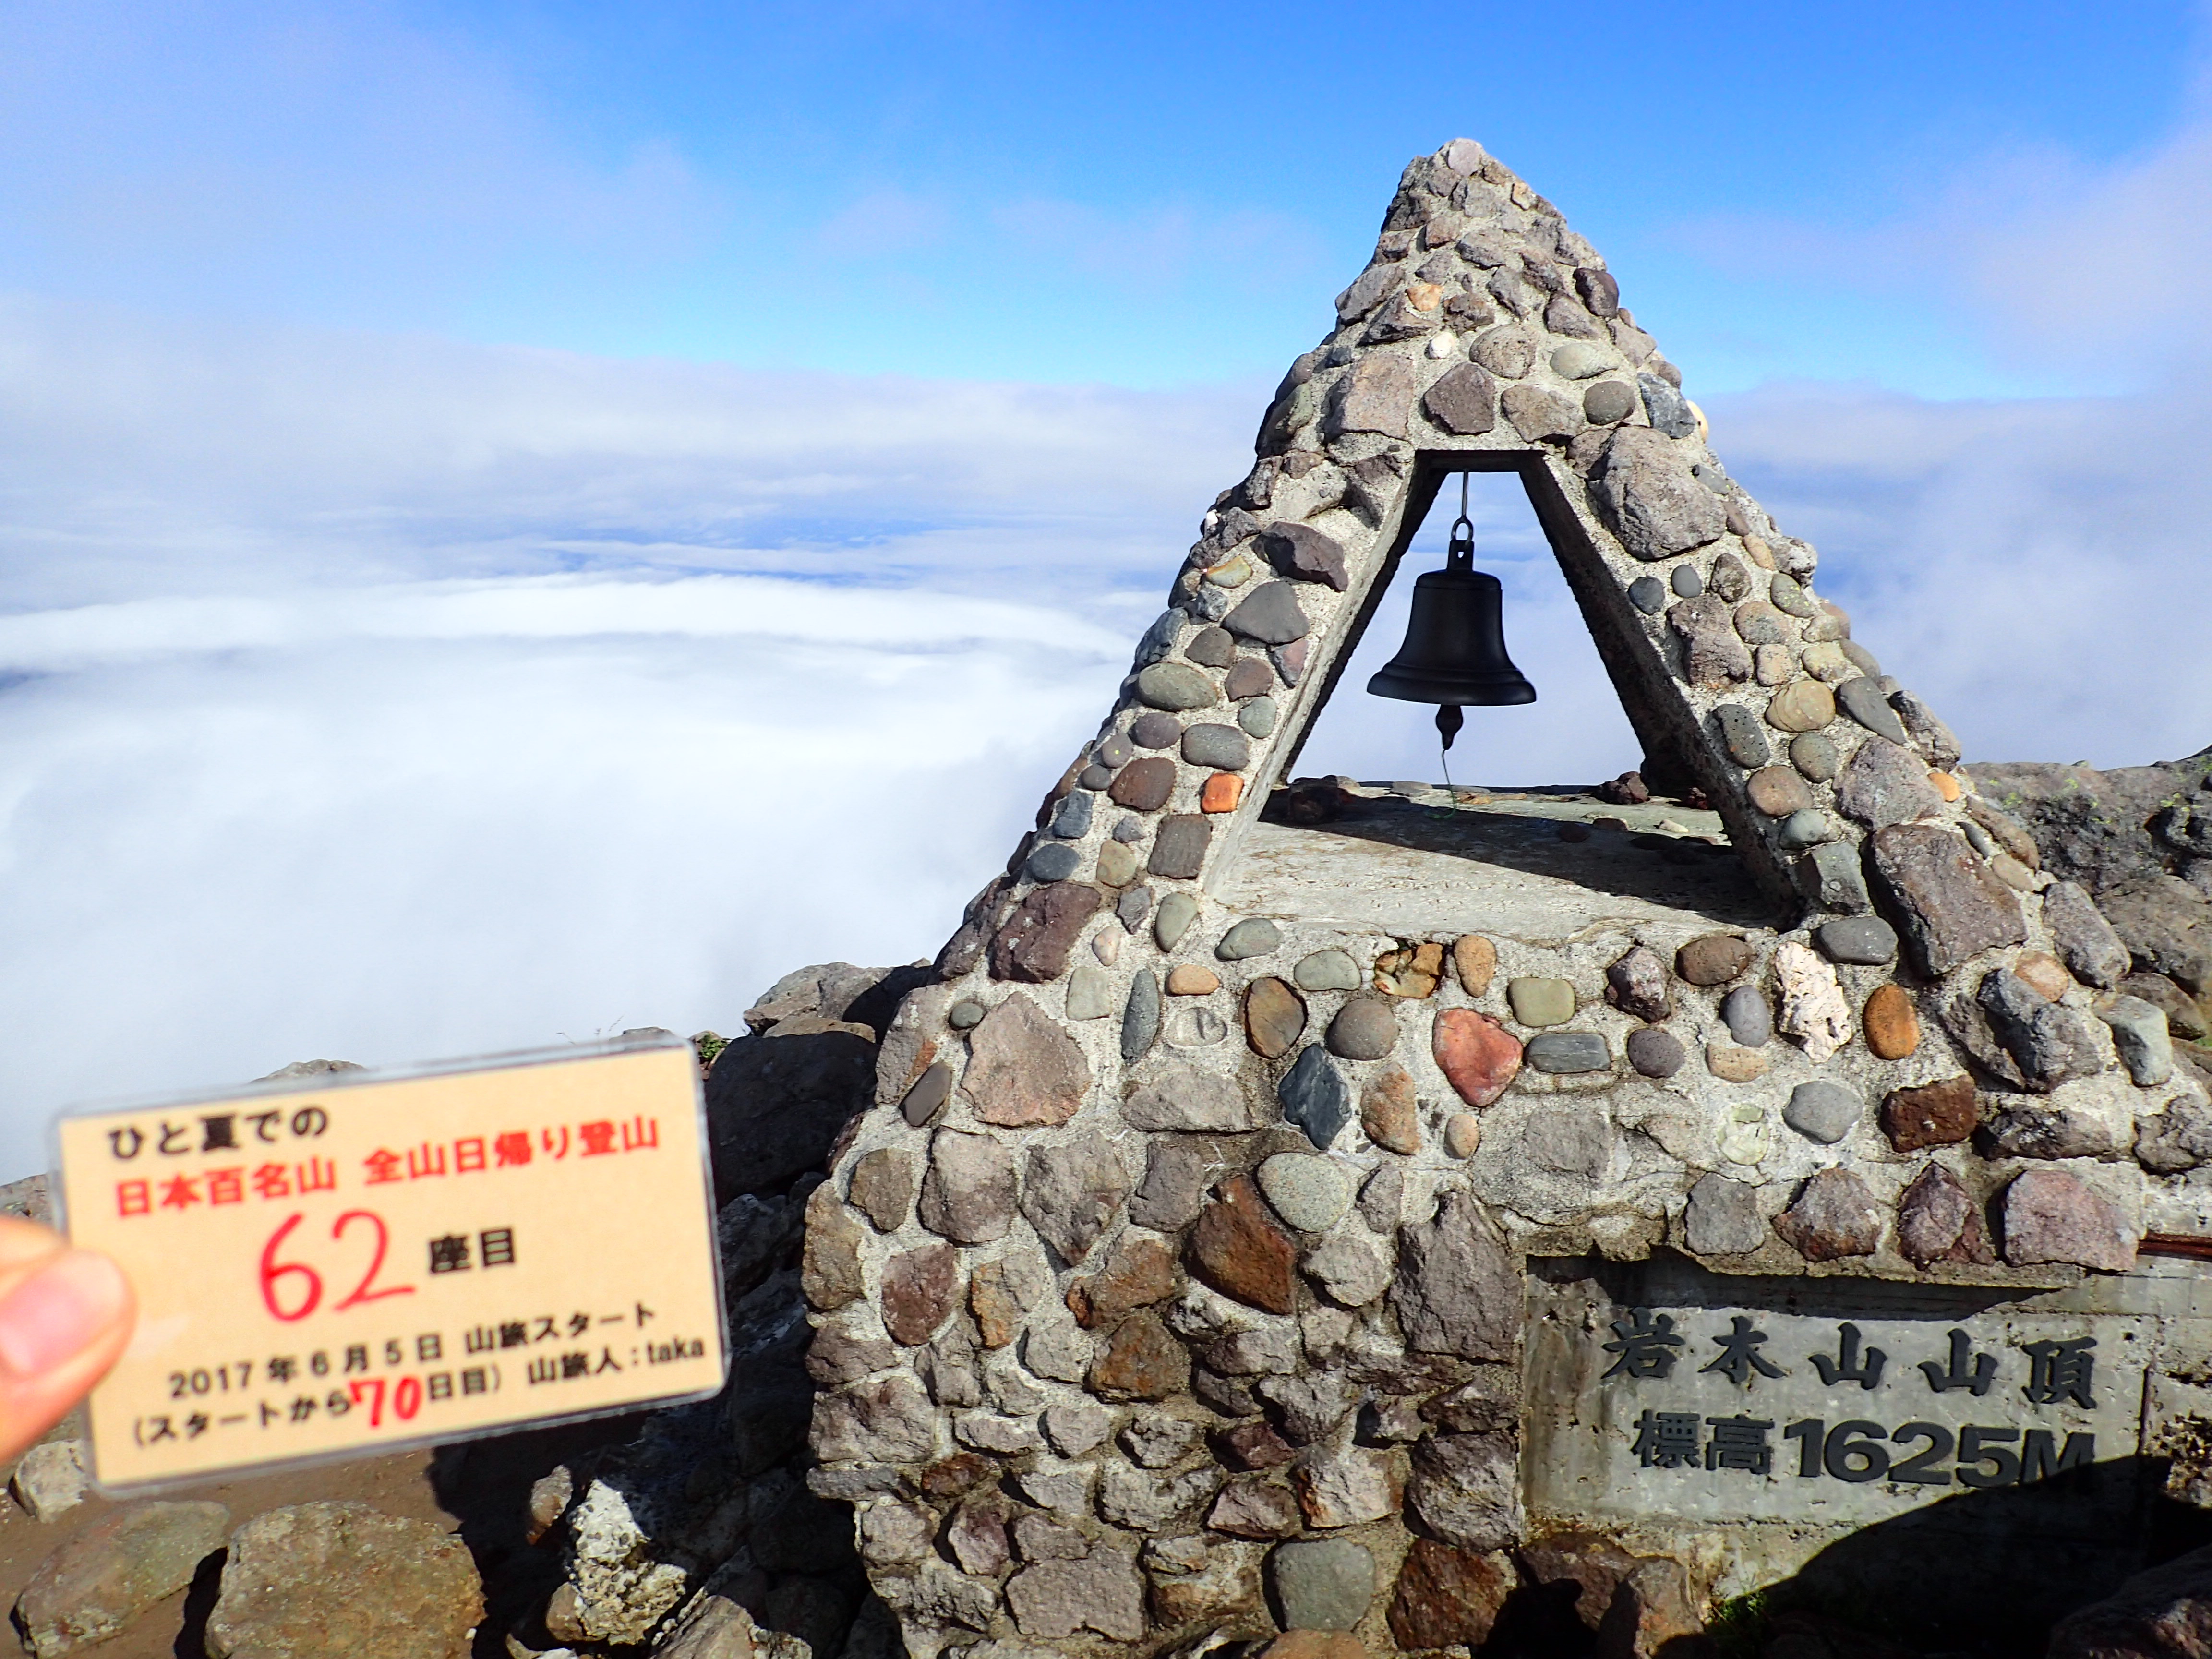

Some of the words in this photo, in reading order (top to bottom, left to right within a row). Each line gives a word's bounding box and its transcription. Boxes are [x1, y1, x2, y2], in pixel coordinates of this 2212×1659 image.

[116, 1156, 338, 1217] 日本百名山
[363, 1115, 661, 1186] 全山日帰り登山
[260, 1210, 416, 1322] 62
[428, 1227, 516, 1274] 座目
[1600, 1307, 2098, 1410] 岩木山山頂
